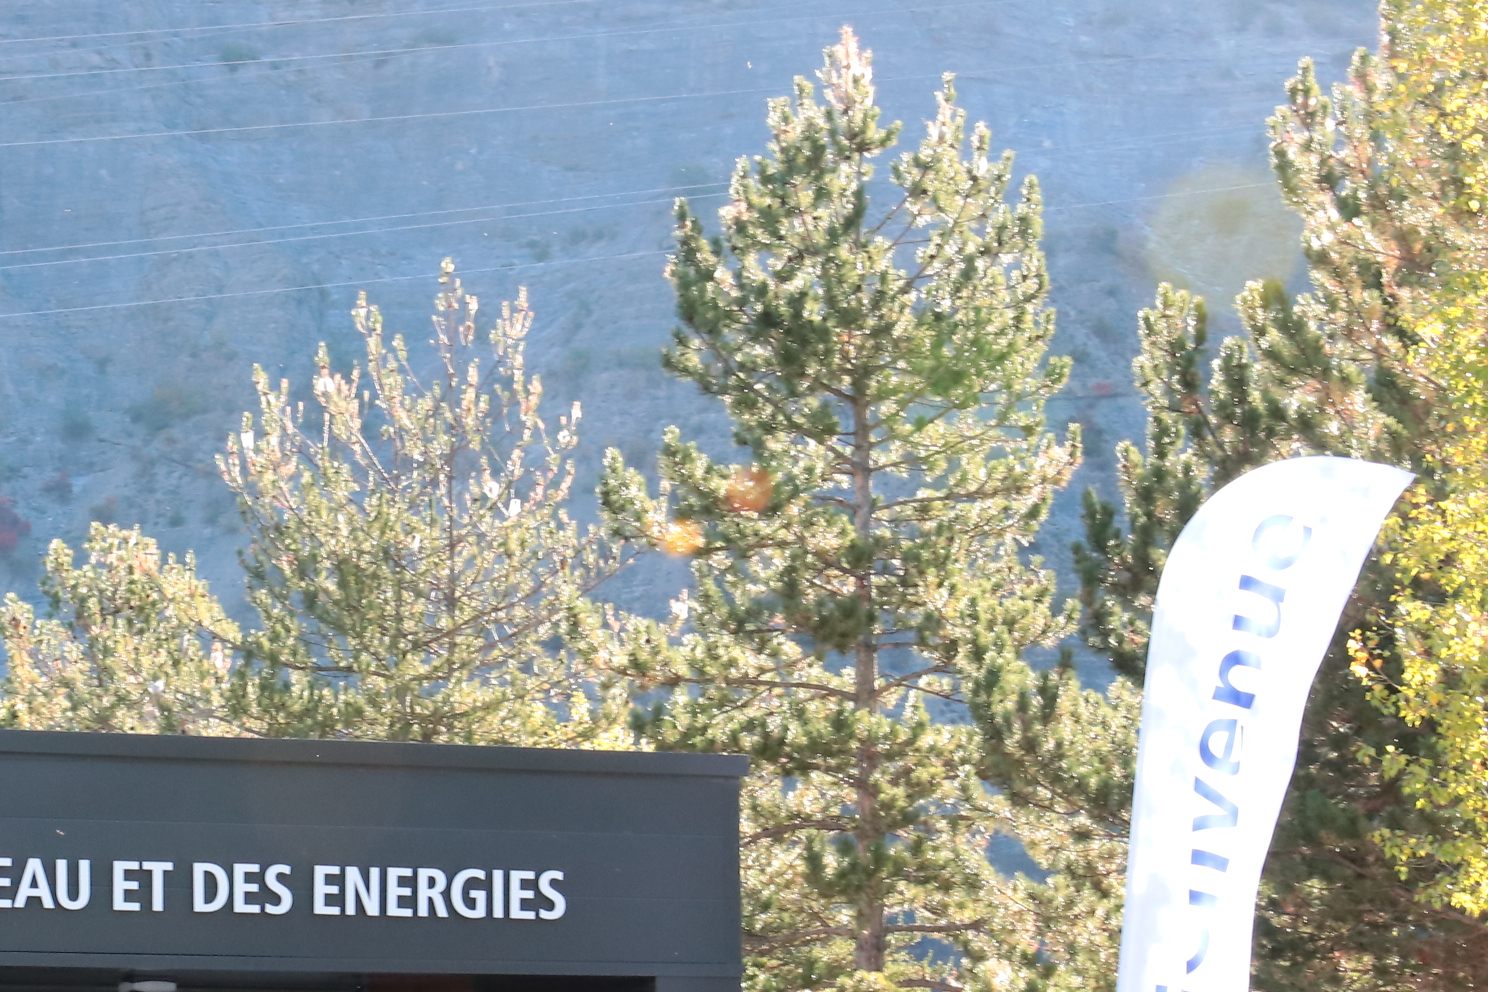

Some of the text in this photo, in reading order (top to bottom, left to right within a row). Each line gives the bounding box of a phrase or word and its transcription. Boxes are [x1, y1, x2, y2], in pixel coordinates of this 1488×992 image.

[111, 860, 174, 912] ET
[192, 862, 294, 916] DES
[313, 865, 568, 921] ENERGIES
